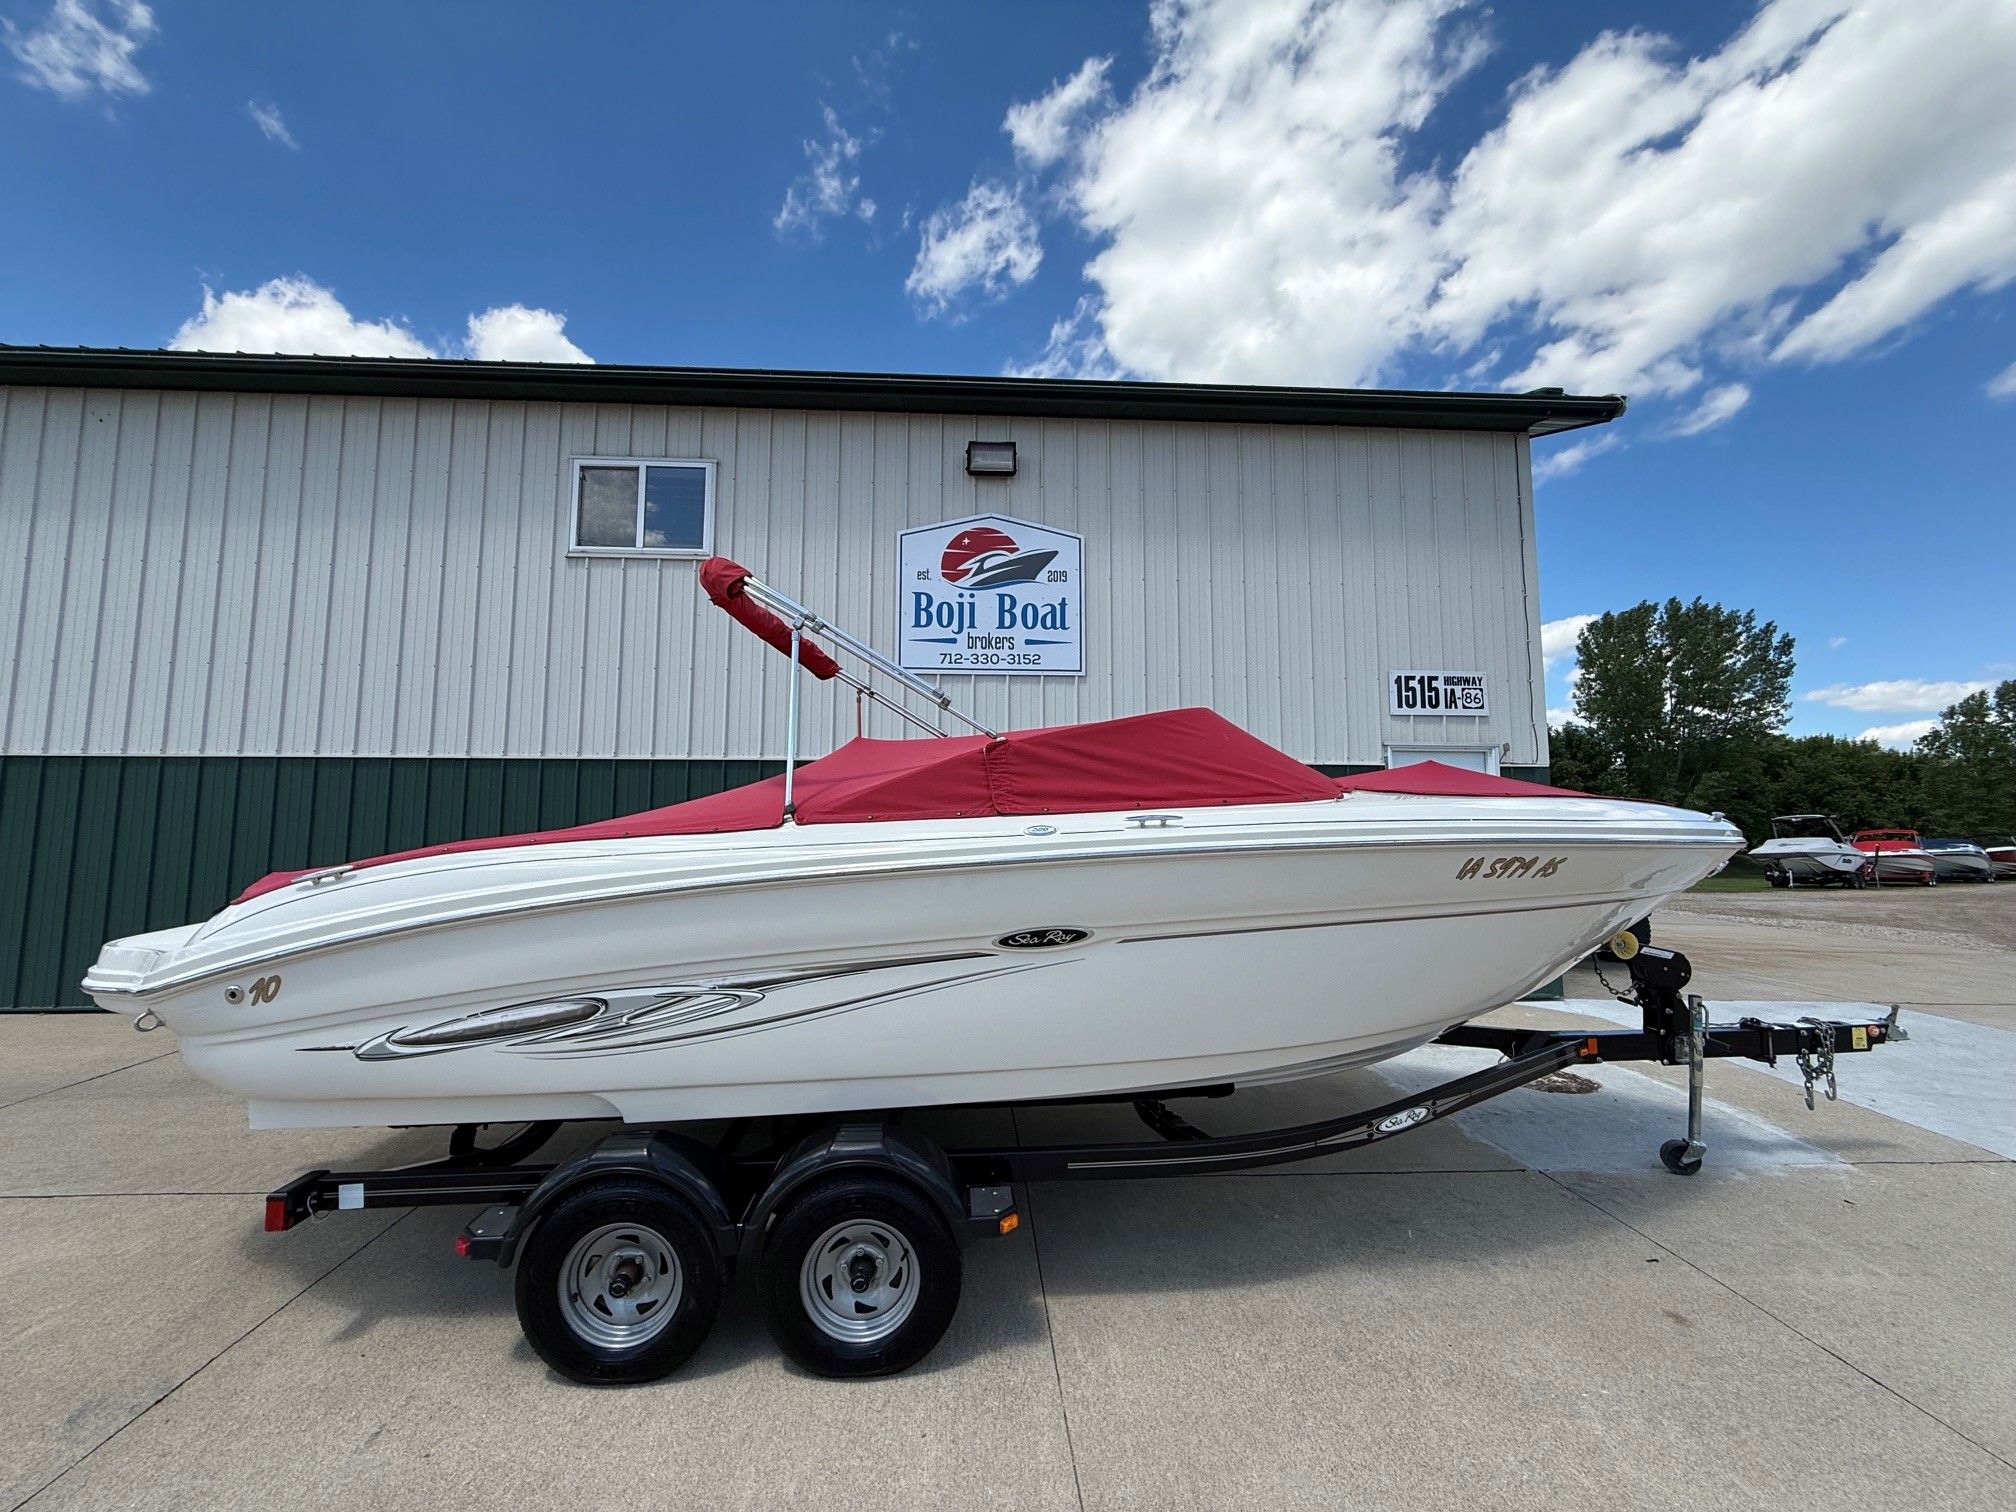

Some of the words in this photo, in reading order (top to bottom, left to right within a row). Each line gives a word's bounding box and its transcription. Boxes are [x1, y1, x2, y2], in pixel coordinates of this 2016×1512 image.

[917, 568, 932, 581] est.
[1047, 570, 1068, 583] 2019
[911, 591, 977, 635] Boji
[995, 593, 1070, 631] Boat
[967, 632, 1015, 650] brokers
[939, 653, 1041, 665] 712-330-3152
[1443, 676, 1483, 687] HIGHWAY
[1394, 675, 1440, 709] 1515
[1455, 857, 1485, 880] IA
[1008, 933, 1041, 945] Sea
[1043, 930, 1077, 943] Ray
